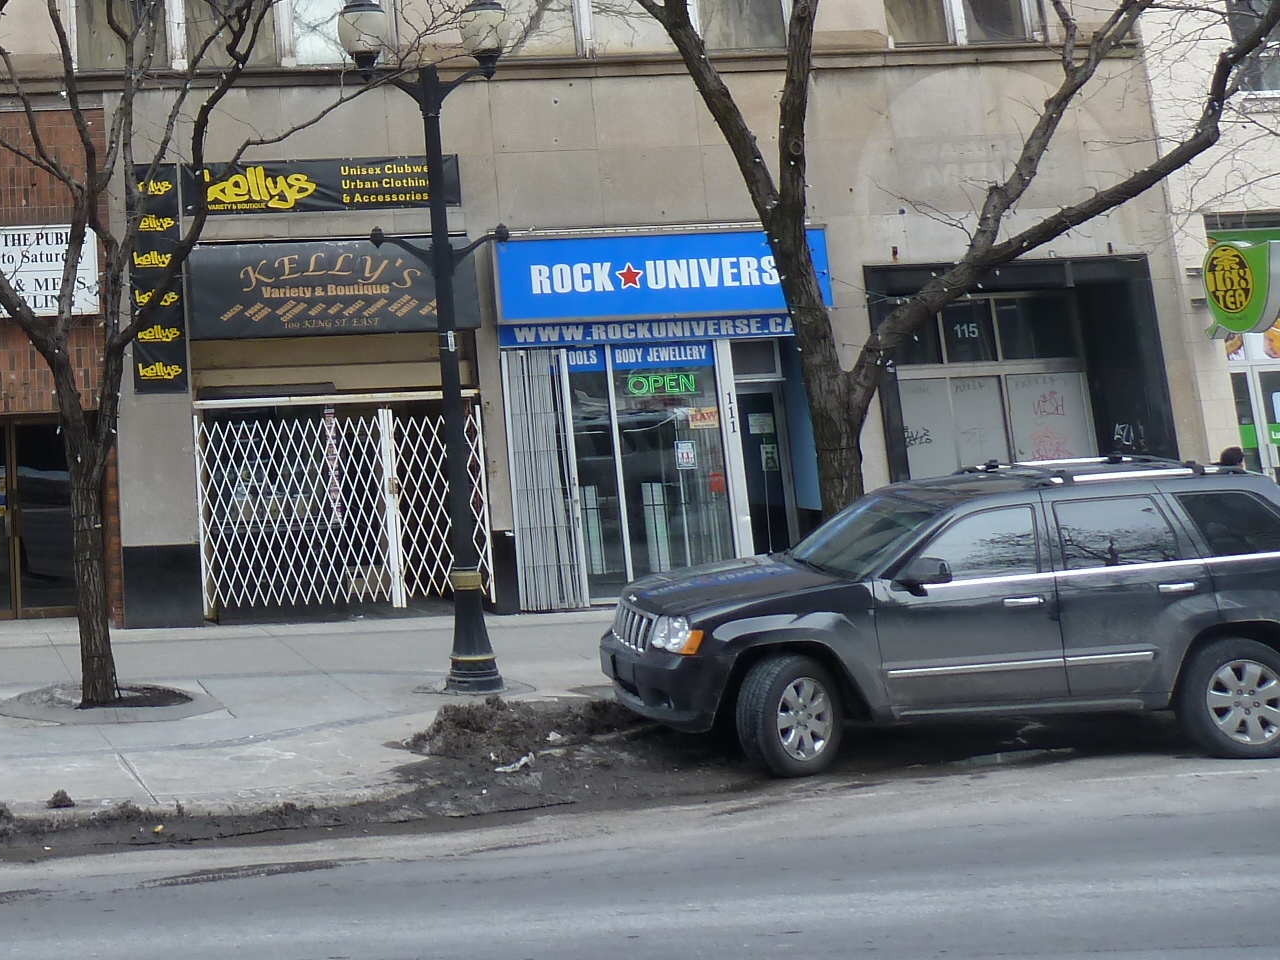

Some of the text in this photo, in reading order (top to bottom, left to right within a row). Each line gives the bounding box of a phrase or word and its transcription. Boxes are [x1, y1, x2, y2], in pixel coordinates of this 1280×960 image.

[340, 164, 429, 176] Unisex Clubwe
[342, 177, 430, 189] Urban Clothin
[342, 191, 429, 203] & Accessories
[139, 214, 175, 231] ellys
[2, 233, 31, 248] THE
[2, 252, 15, 265] to
[239, 252, 422, 292] KELLY'S
[530, 255, 781, 295] ROCK UNIVERS
[1211, 268, 1250, 290] 168
[14, 278, 26, 292] &
[261, 283, 390, 299] Variety & Boutique
[1216, 290, 1246, 311] TEA
[303, 319, 332, 329] KING
[352, 317, 380, 327] EAST
[513, 317, 794, 343] WWW.ROCKUNIVERSE.CA
[953, 323, 979, 338] 115
[569, 345, 707, 366] OOLS BODY JEWELLERY
[138, 362, 182, 379] kellys
[628, 373, 696, 395] OPEN
[689, 410, 719, 423] RAW
